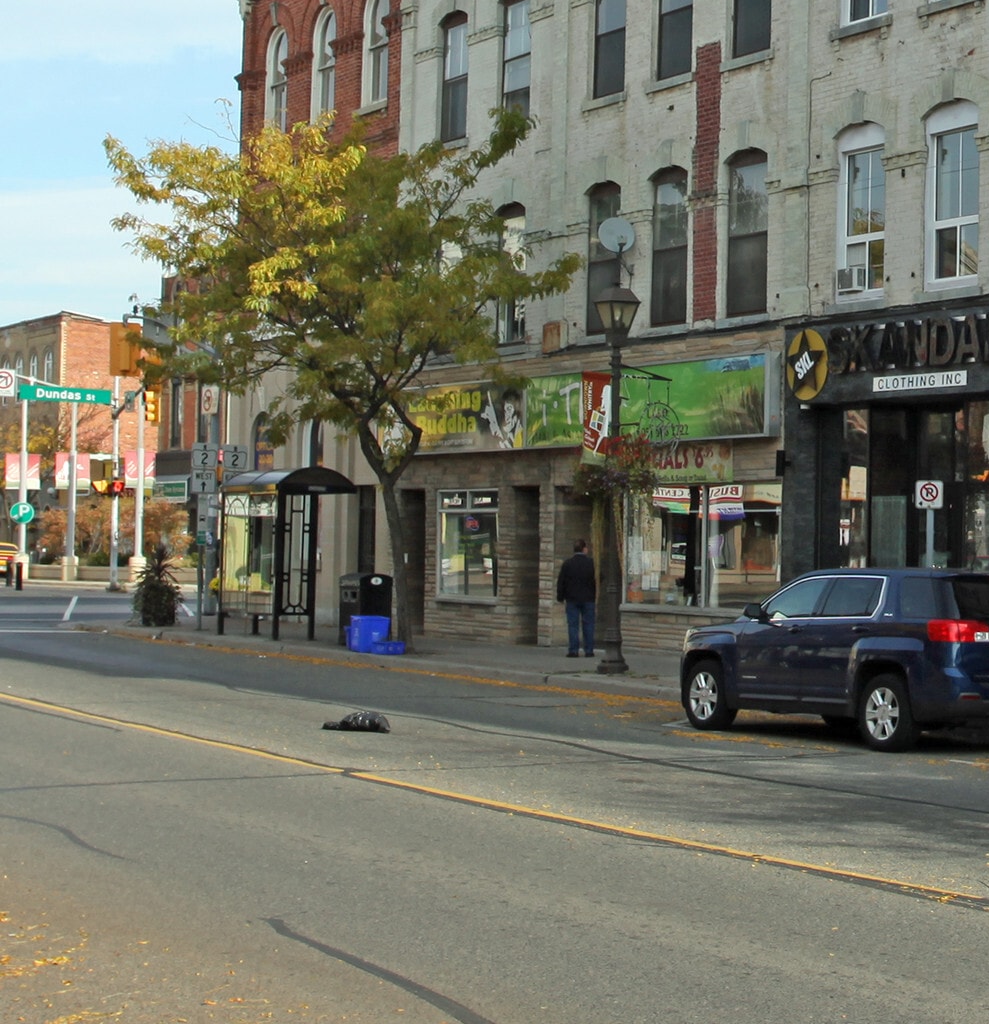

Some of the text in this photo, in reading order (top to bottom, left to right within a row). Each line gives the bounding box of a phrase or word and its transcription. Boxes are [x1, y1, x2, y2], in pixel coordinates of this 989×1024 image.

[877, 373, 962, 390] CLOTHING INC
[36, 388, 96, 401] Dundas St
[416, 414, 477, 435] Buddha
[201, 452, 208, 465] 2
[231, 454, 239, 467] 2
[196, 472, 212, 480] WEST
